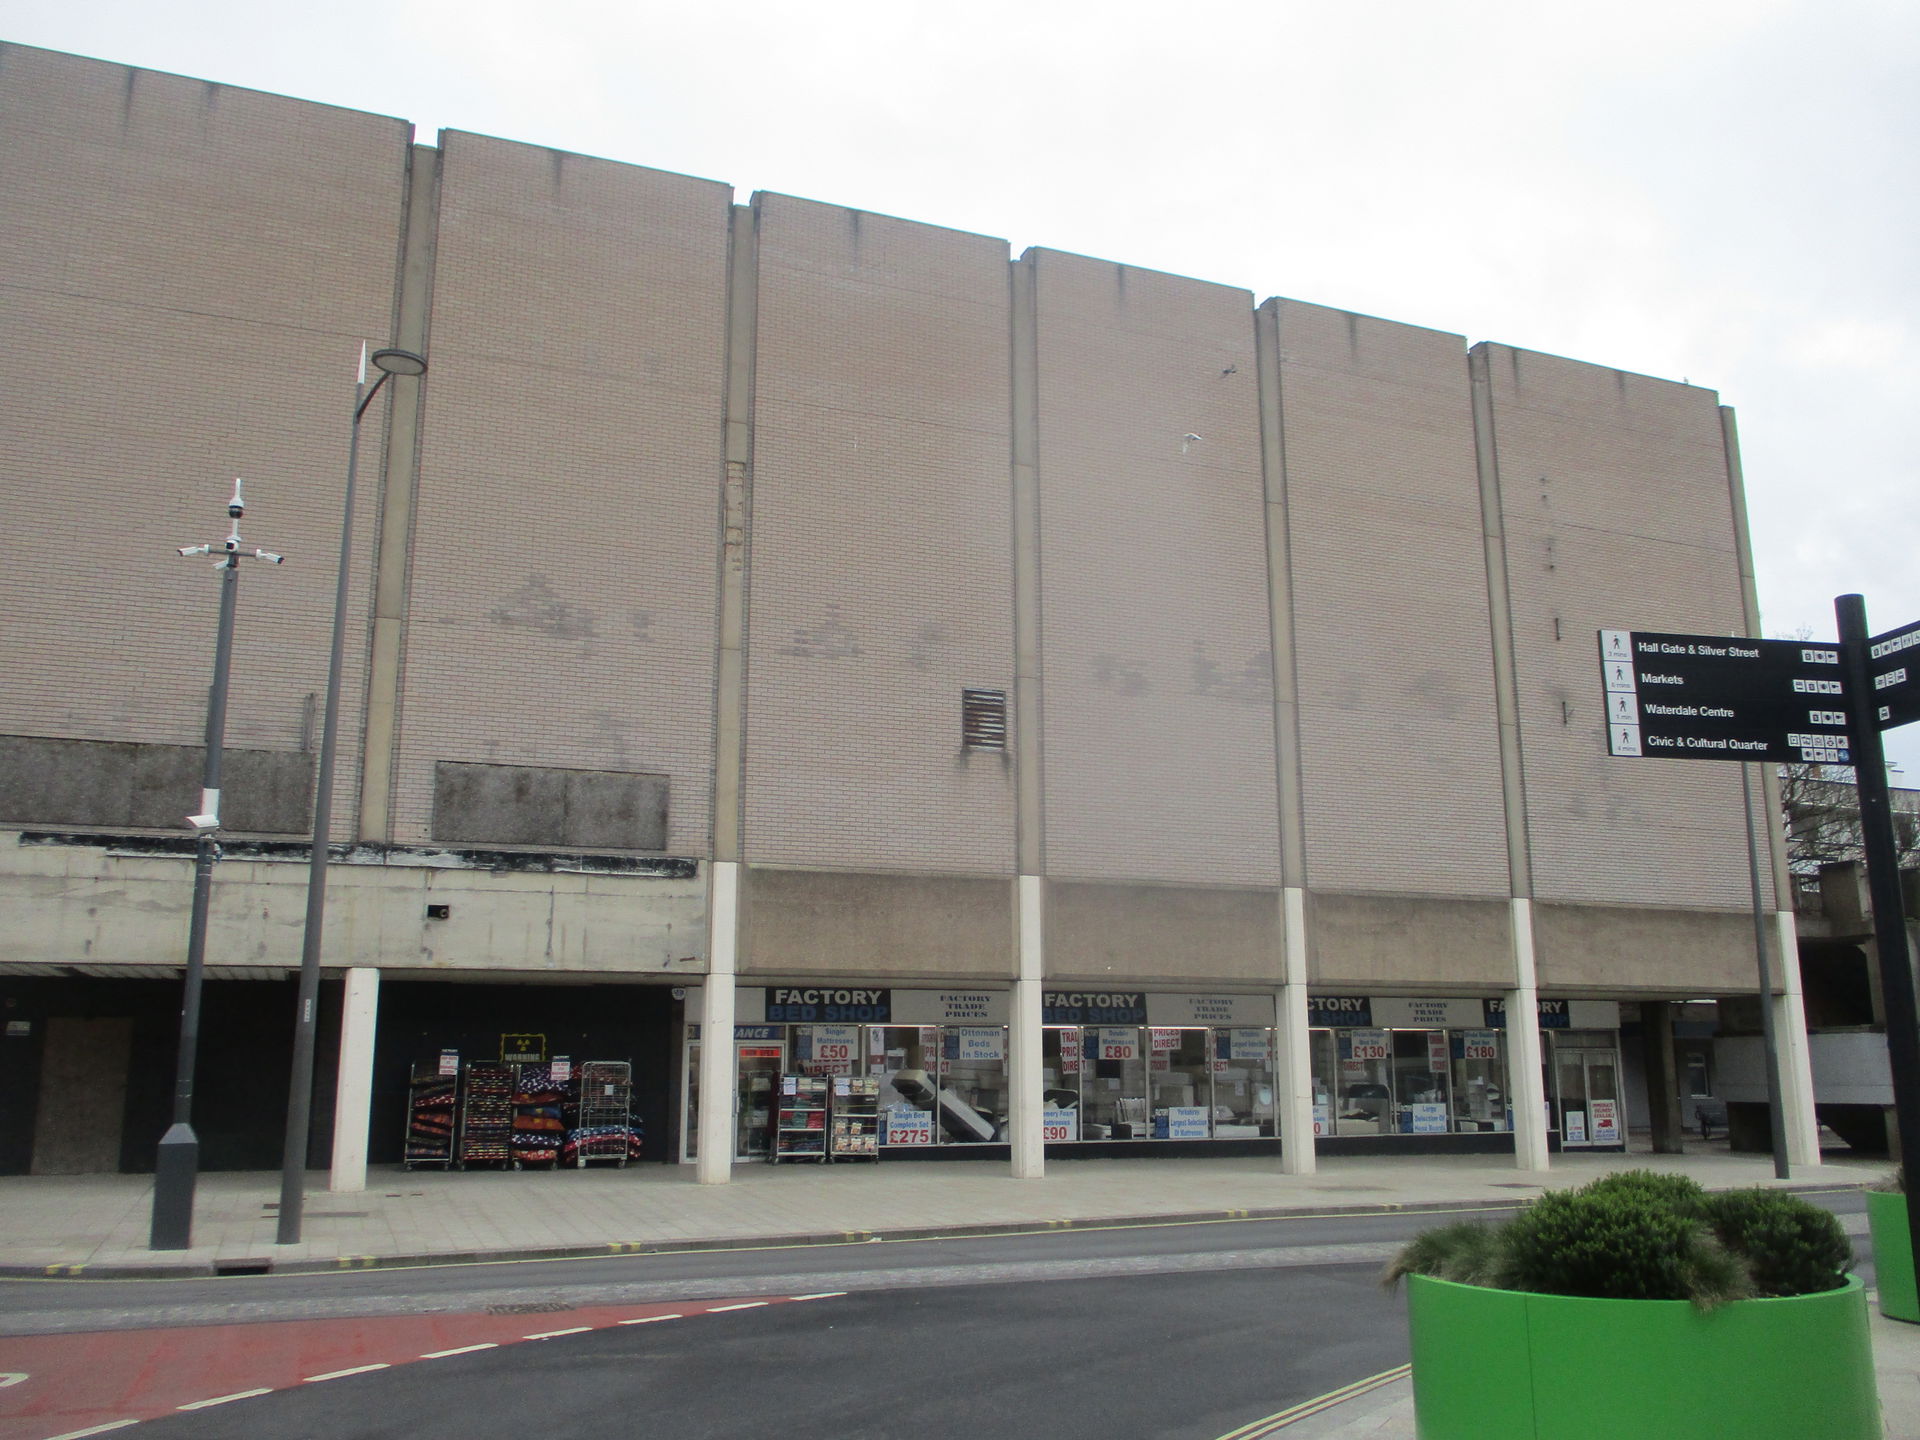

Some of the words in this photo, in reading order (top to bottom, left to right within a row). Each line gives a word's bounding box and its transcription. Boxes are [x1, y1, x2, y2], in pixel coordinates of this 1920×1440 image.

[1638, 642, 1659, 653] Hall
[1661, 643, 1686, 654] Gate
[1688, 645, 1696, 655] &
[1698, 645, 1726, 656] Silver
[1728, 646, 1760, 658] Street
[1641, 673, 1684, 685] Markets
[1645, 704, 1697, 716] Waterdale
[1700, 706, 1734, 718] Centre
[1648, 735, 1674, 747] Civic
[1676, 737, 1685, 748] &
[1687, 738, 1727, 749] Cultural
[1729, 739, 1769, 751] Quarter
[775, 989, 882, 1005] FACTORY
[1044, 993, 1138, 1008] FACTORY
[1308, 998, 1363, 1011] CTORY
[768, 1005, 817, 1020] BED
[824, 1006, 888, 1020] SHOP
[1088, 1009, 1145, 1023] SHOP
[825, 1028, 846, 1036] Single
[961, 1029, 1000, 1037] Ottoman
[1154, 1038, 1180, 1048] DIRECT
[505, 1053, 540, 1061] WARNING
[820, 1045, 848, 1058] £50
[974, 1050, 999, 1058] Stock
[1105, 1046, 1132, 1058] £80
[1354, 1046, 1385, 1058] £130
[1466, 1046, 1495, 1058] £180
[924, 1061, 949, 1072] DIRCT
[1063, 1061, 1086, 1072] DIRET
[895, 1112, 912, 1120] Sleigh
[890, 1121, 917, 1129] Complete
[889, 1129, 929, 1143] £275
